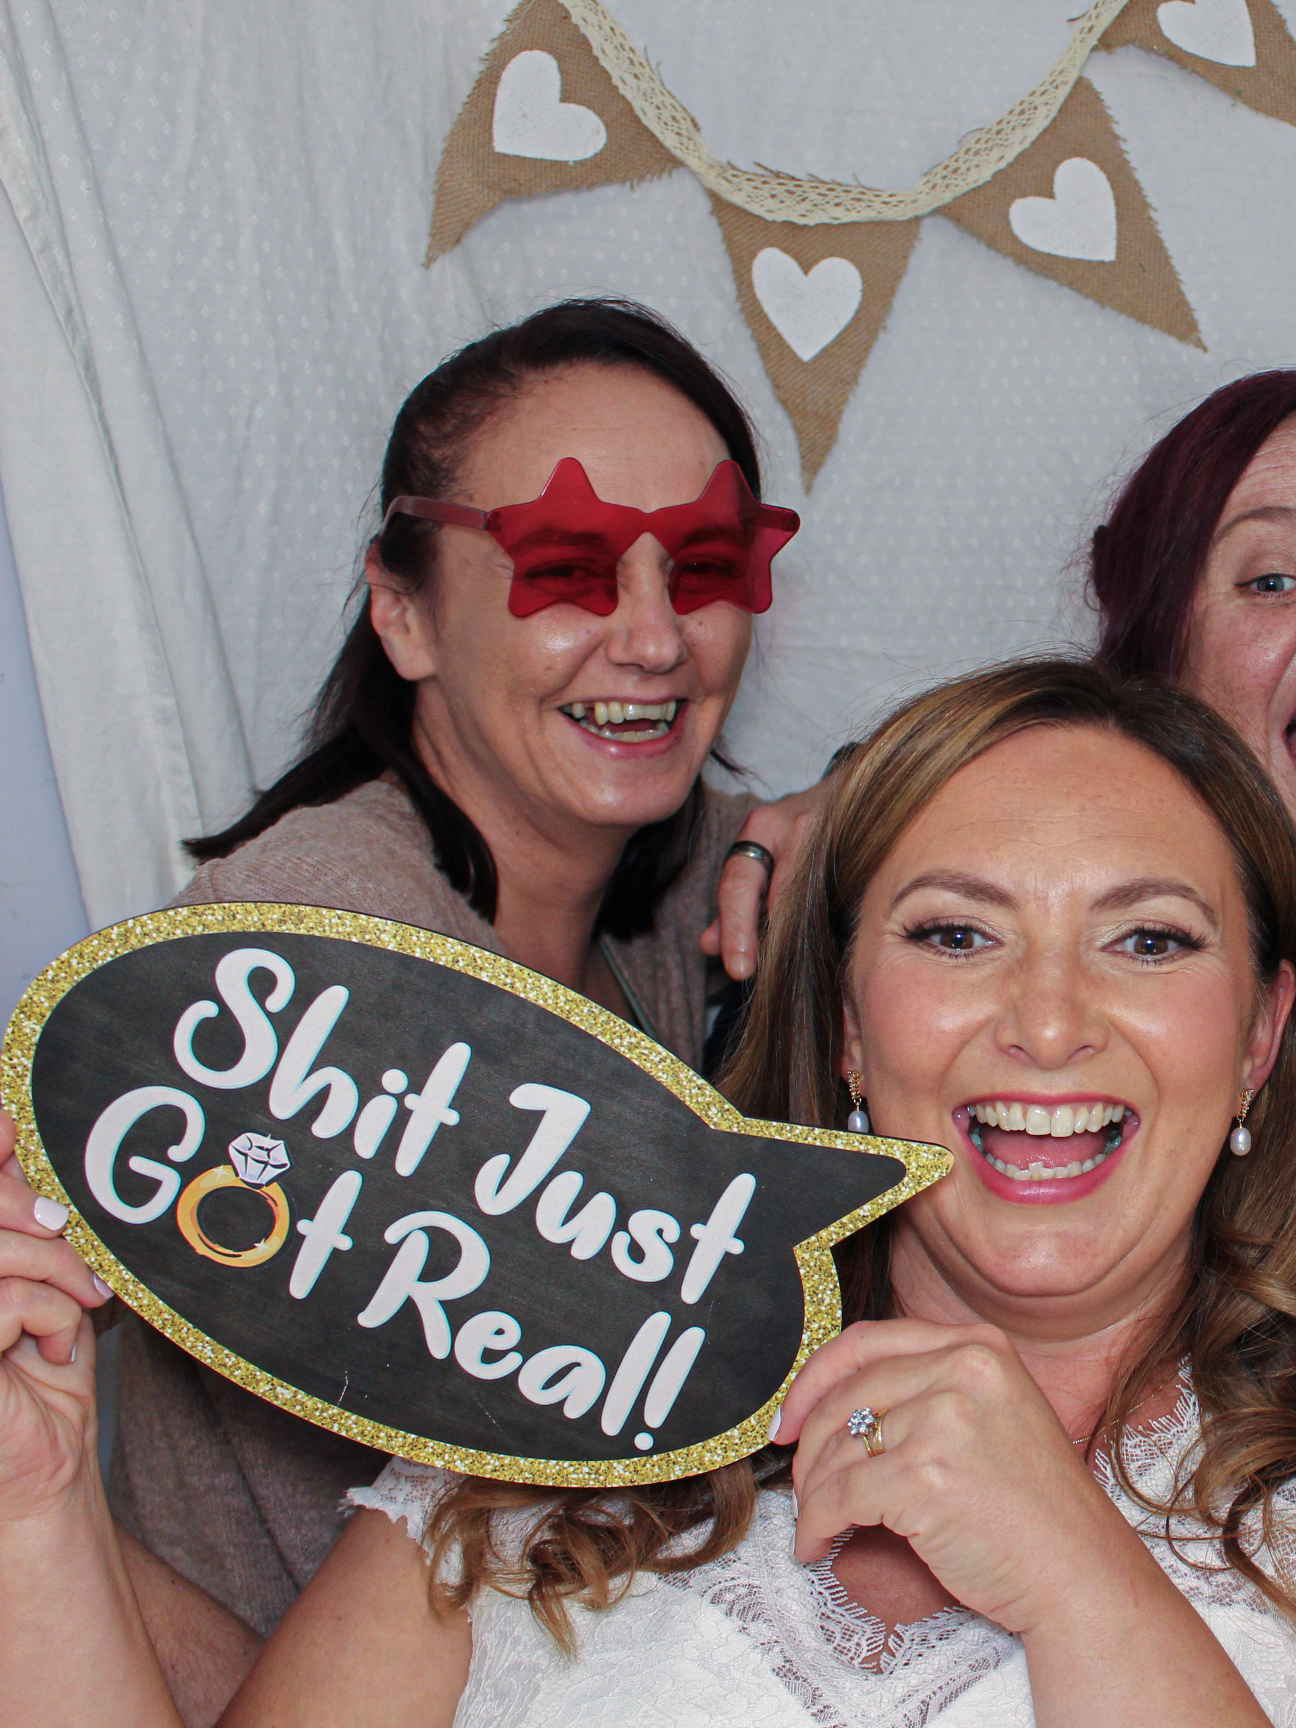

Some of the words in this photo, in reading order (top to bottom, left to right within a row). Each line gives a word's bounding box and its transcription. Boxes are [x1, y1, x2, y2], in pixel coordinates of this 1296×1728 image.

[84, 1085, 364, 1300] Got
[357, 1210, 706, 1451] Real!
[173, 948, 471, 1177] Shit
[474, 1083, 757, 1305] Just
